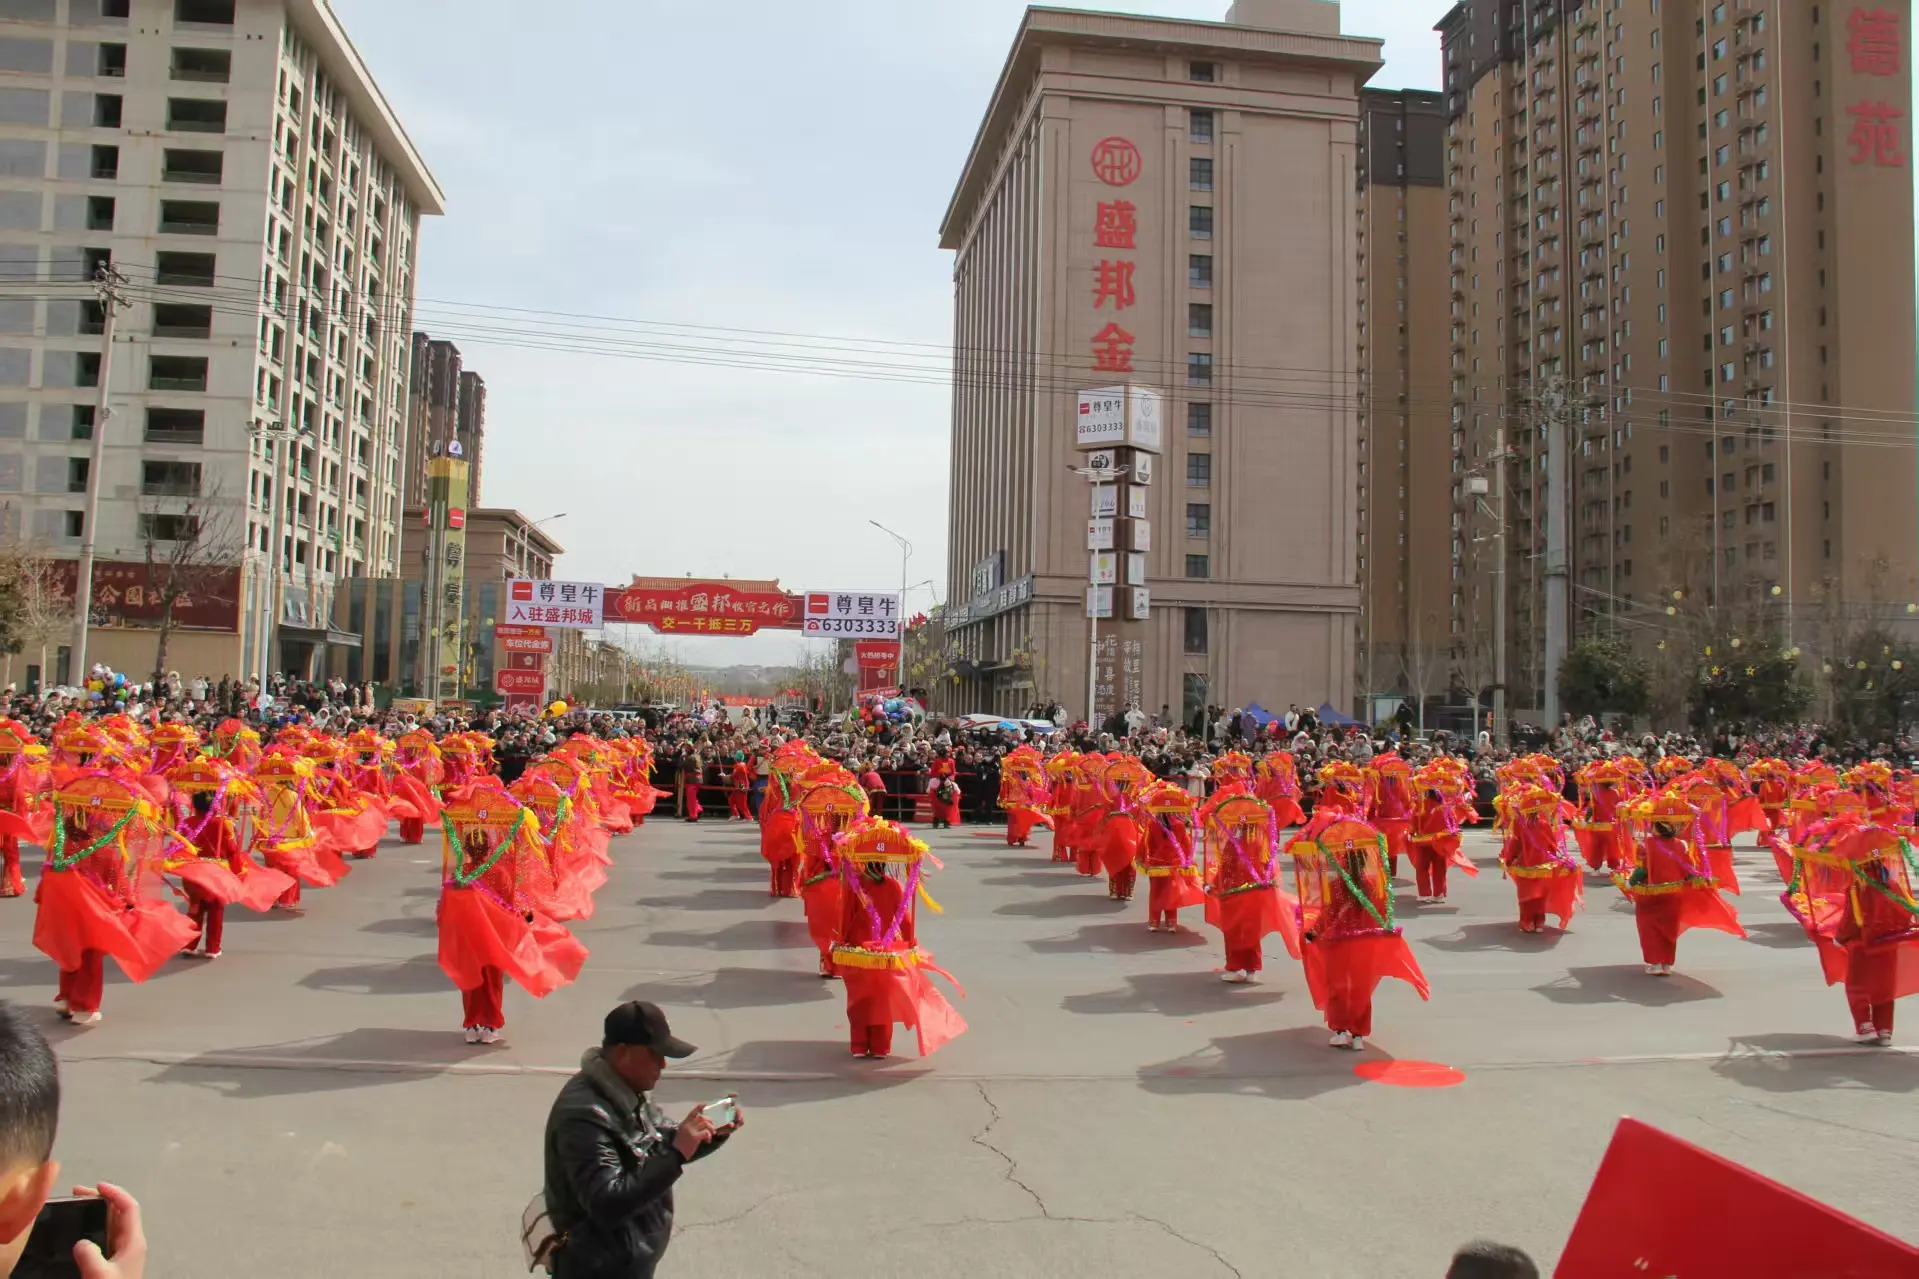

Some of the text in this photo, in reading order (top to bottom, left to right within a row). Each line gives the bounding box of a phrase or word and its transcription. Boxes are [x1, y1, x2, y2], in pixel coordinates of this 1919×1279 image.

[1091, 199, 1137, 373] 盛邦金
[1086, 422, 1123, 433] 6303333
[540, 582, 598, 604] 尊皇牛
[836, 594, 896, 616] 尊皇牛
[511, 605, 594, 625] 入驻盛邦城
[662, 616, 753, 631] 交一千抵三万
[822, 618, 896, 634] 6303333
[825, 803, 833, 813] 47
[876, 842, 885, 852] 48
